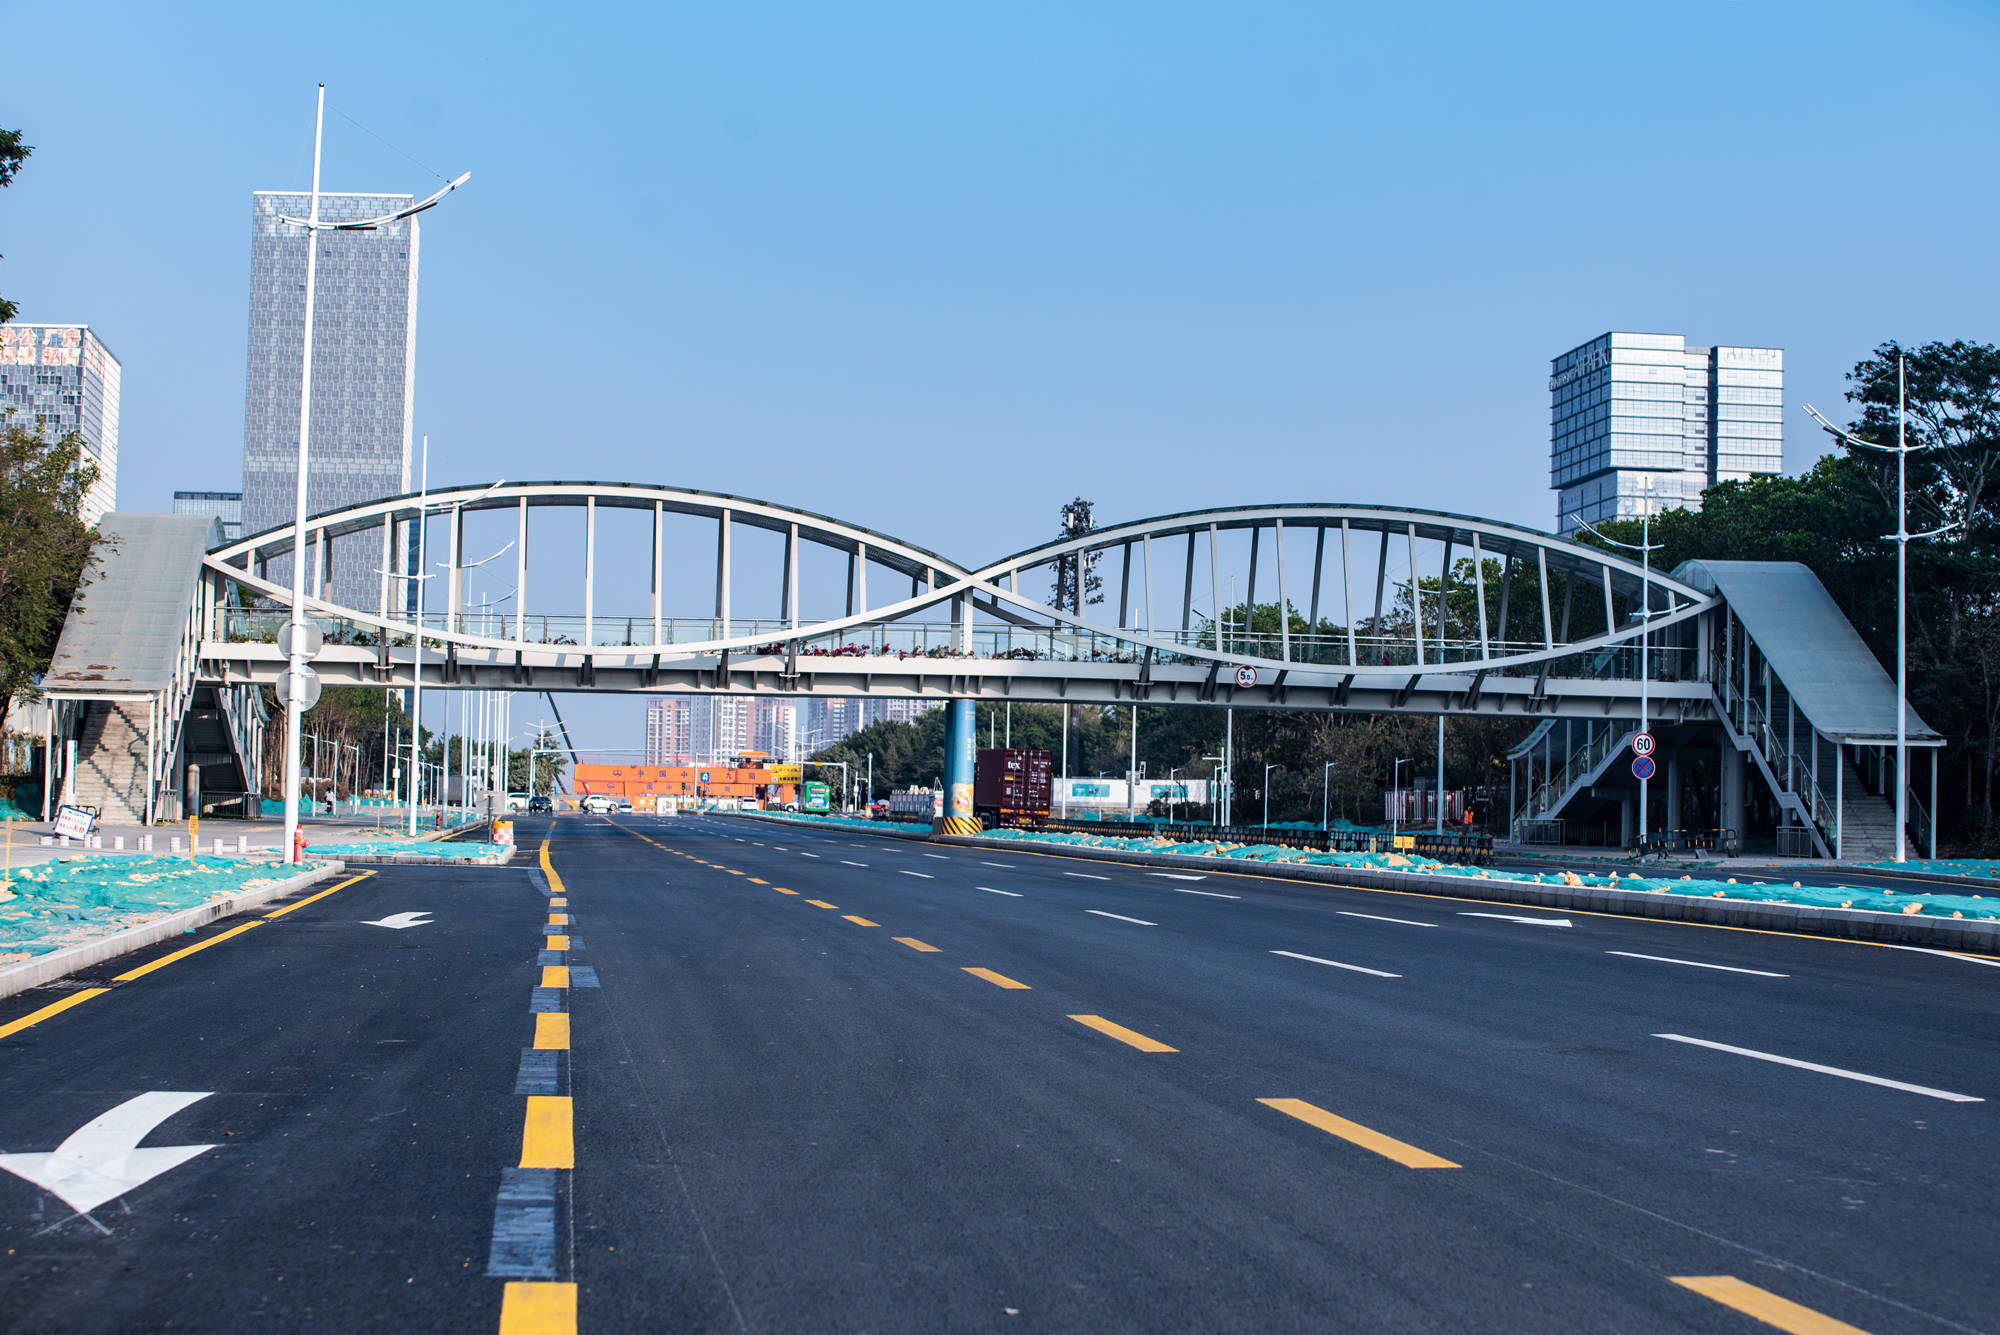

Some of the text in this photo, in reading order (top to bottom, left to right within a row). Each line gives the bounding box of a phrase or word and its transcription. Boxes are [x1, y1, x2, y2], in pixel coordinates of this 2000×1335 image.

[42, 328, 81, 347] 厂房
[1637, 738, 1651, 751] 60
[1007, 761, 1021, 770] tex
